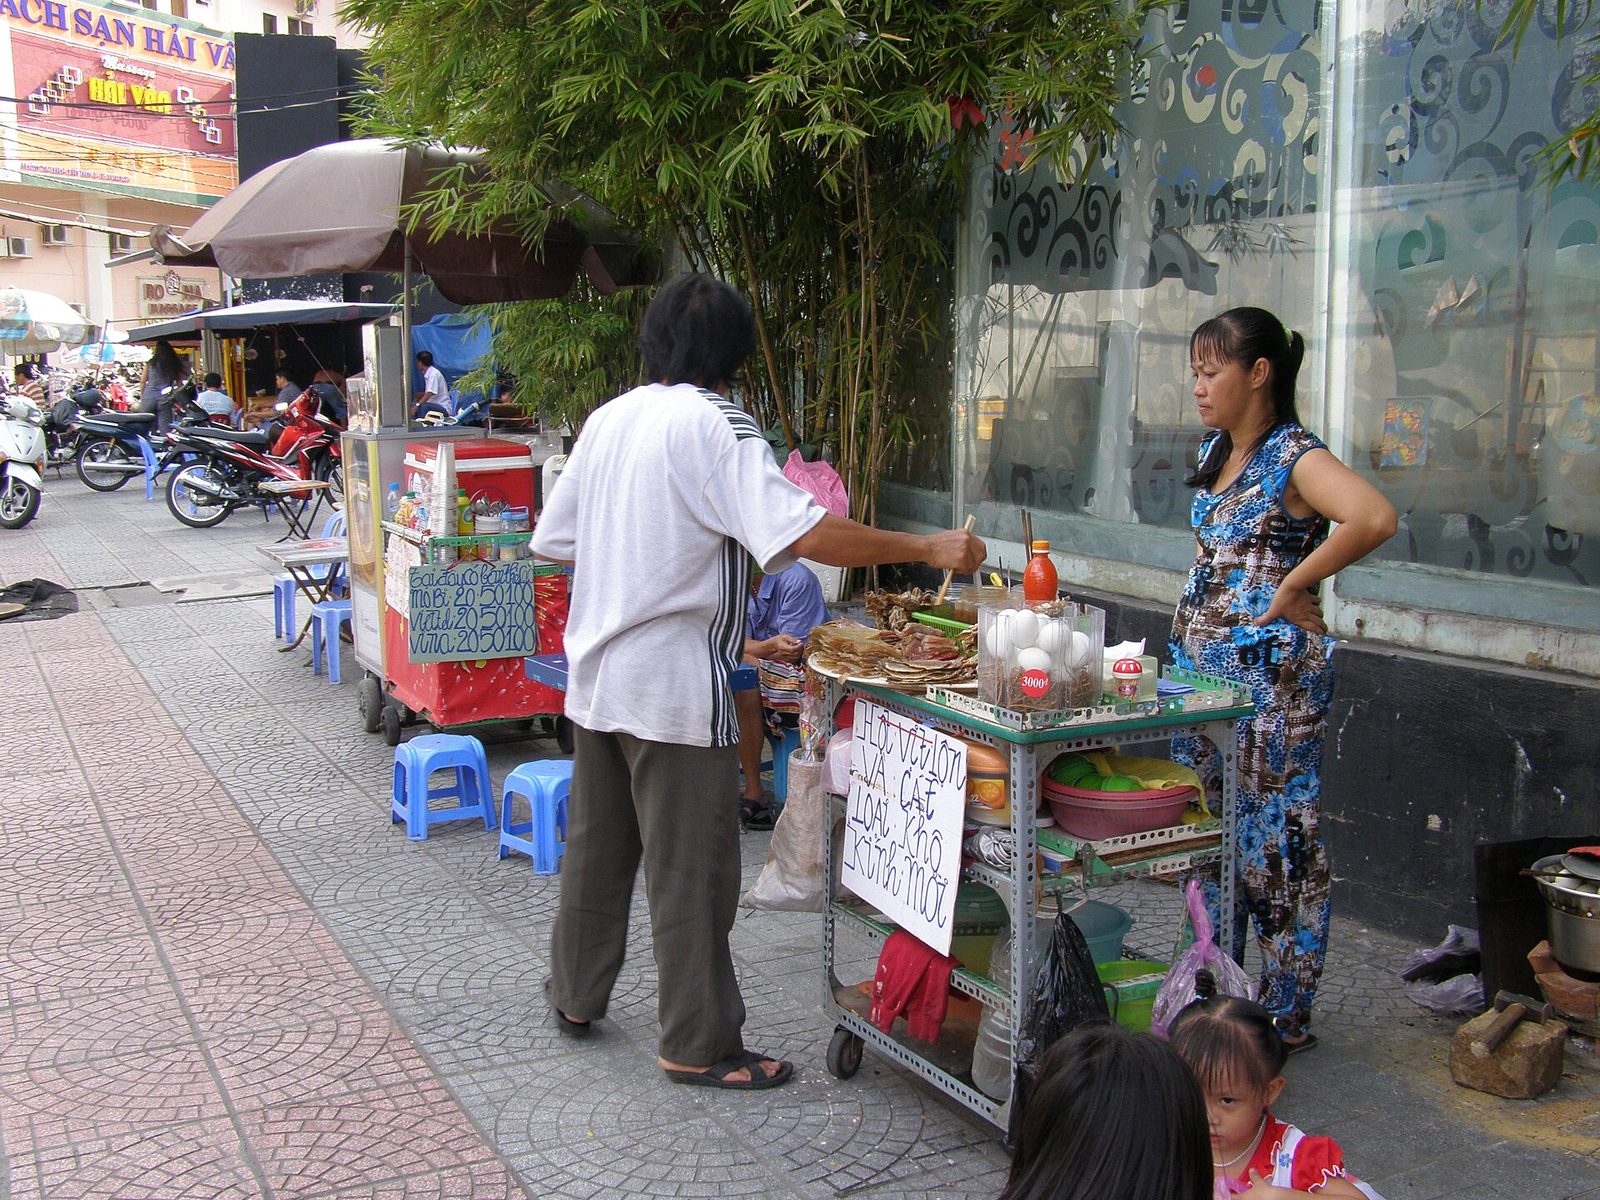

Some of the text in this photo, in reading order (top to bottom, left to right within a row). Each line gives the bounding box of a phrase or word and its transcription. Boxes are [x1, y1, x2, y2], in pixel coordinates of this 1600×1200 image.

[0, 0, 236, 71] ACH SẠN HẢI VÂ
